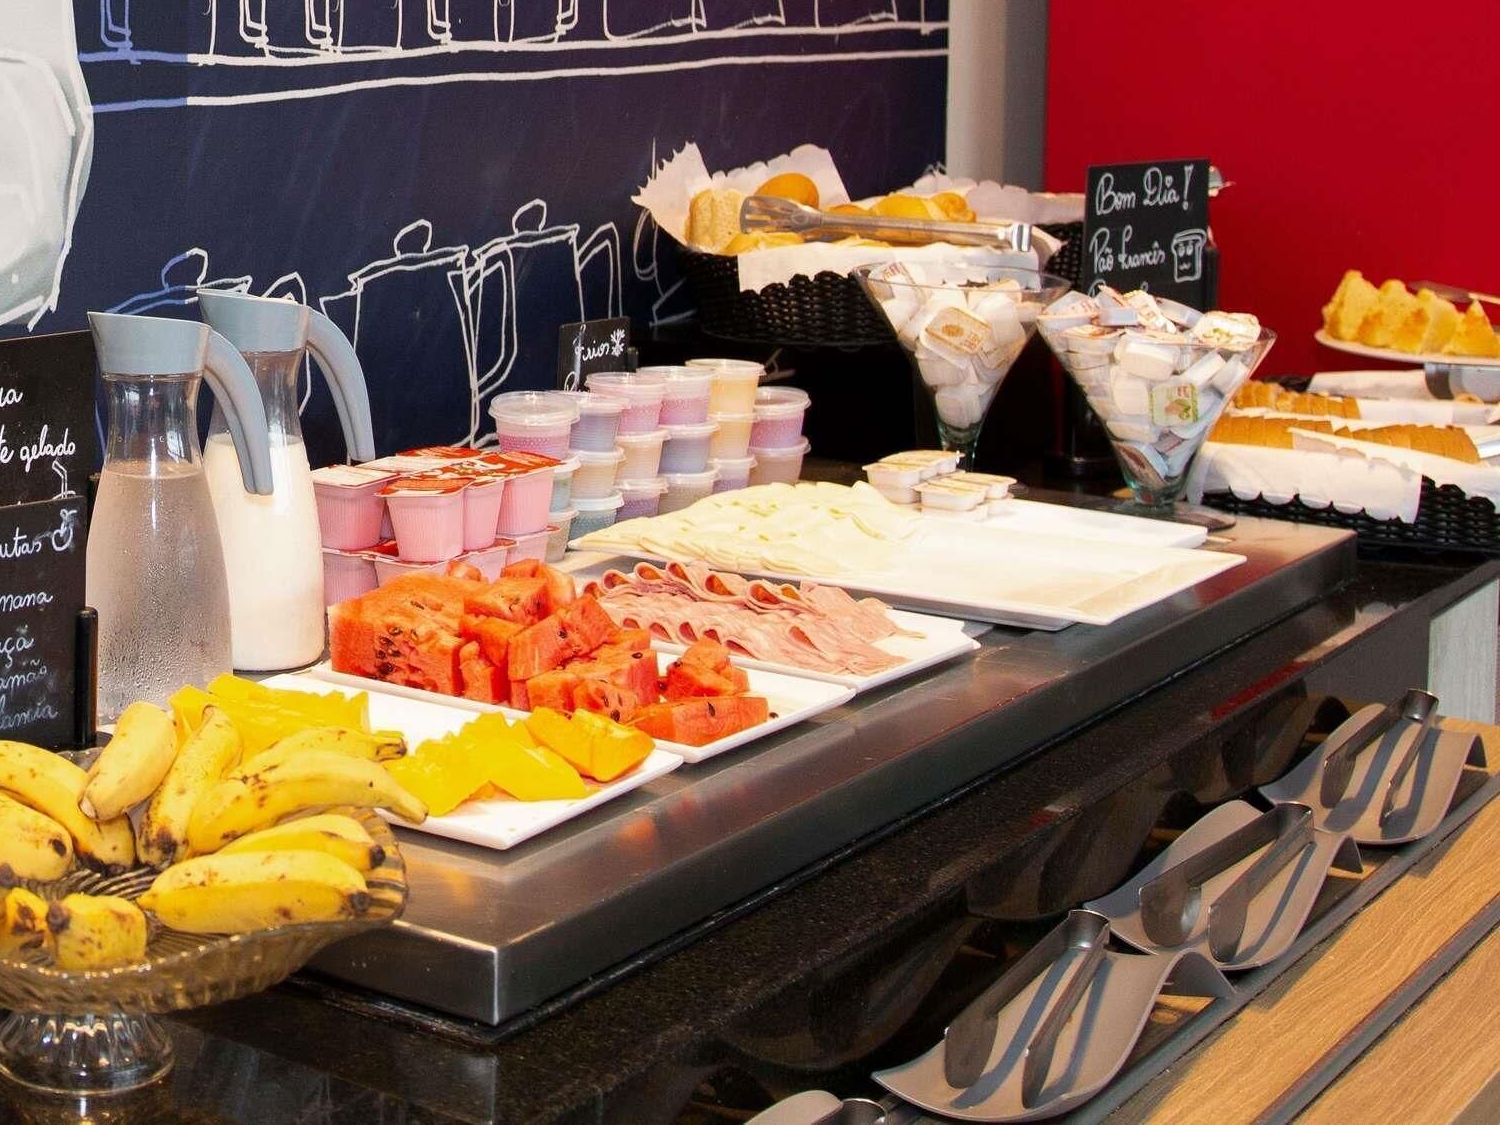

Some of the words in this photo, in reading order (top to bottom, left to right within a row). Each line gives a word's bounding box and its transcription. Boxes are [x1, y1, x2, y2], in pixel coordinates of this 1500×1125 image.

[1095, 173, 1136, 215] Bom
[1089, 227, 1114, 274] Pão
[20, 424, 76, 473] gelado
